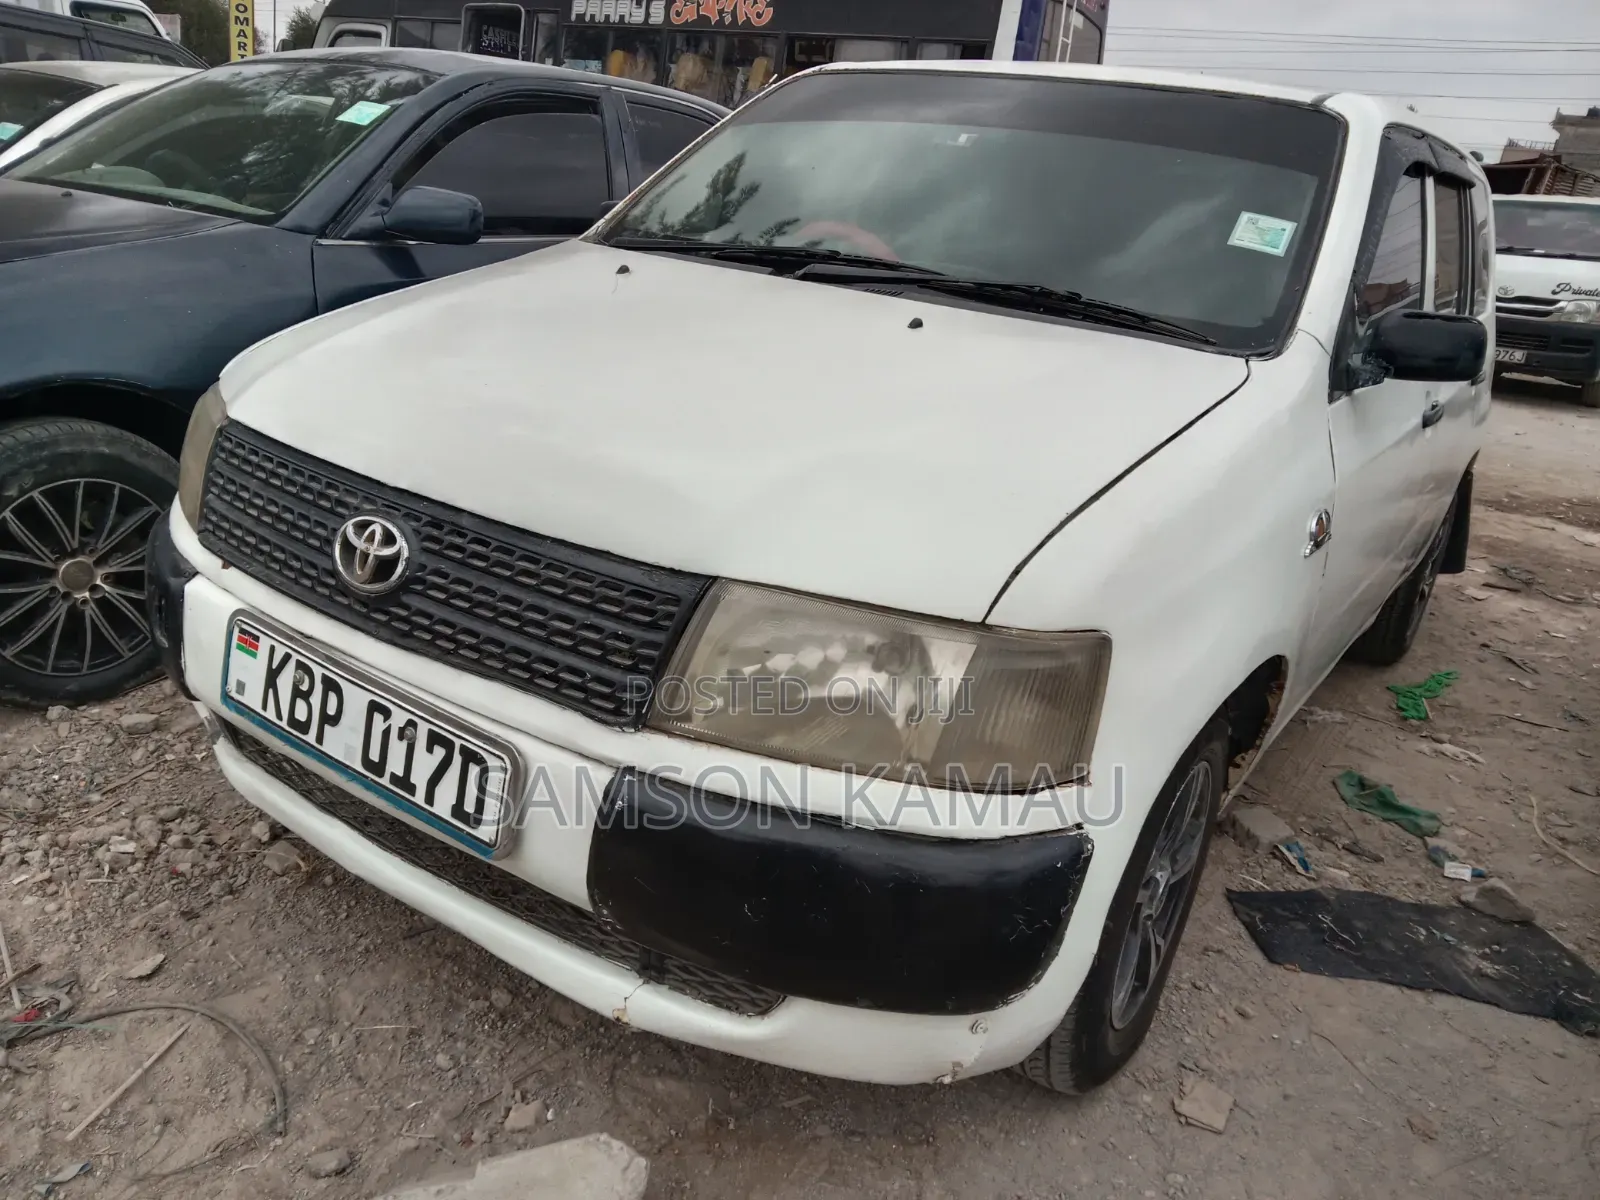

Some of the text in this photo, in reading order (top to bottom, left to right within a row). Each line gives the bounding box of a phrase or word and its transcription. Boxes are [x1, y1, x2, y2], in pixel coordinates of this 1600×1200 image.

[234, 0, 250, 59] OMART
[261, 644, 489, 829] KBP 017D
